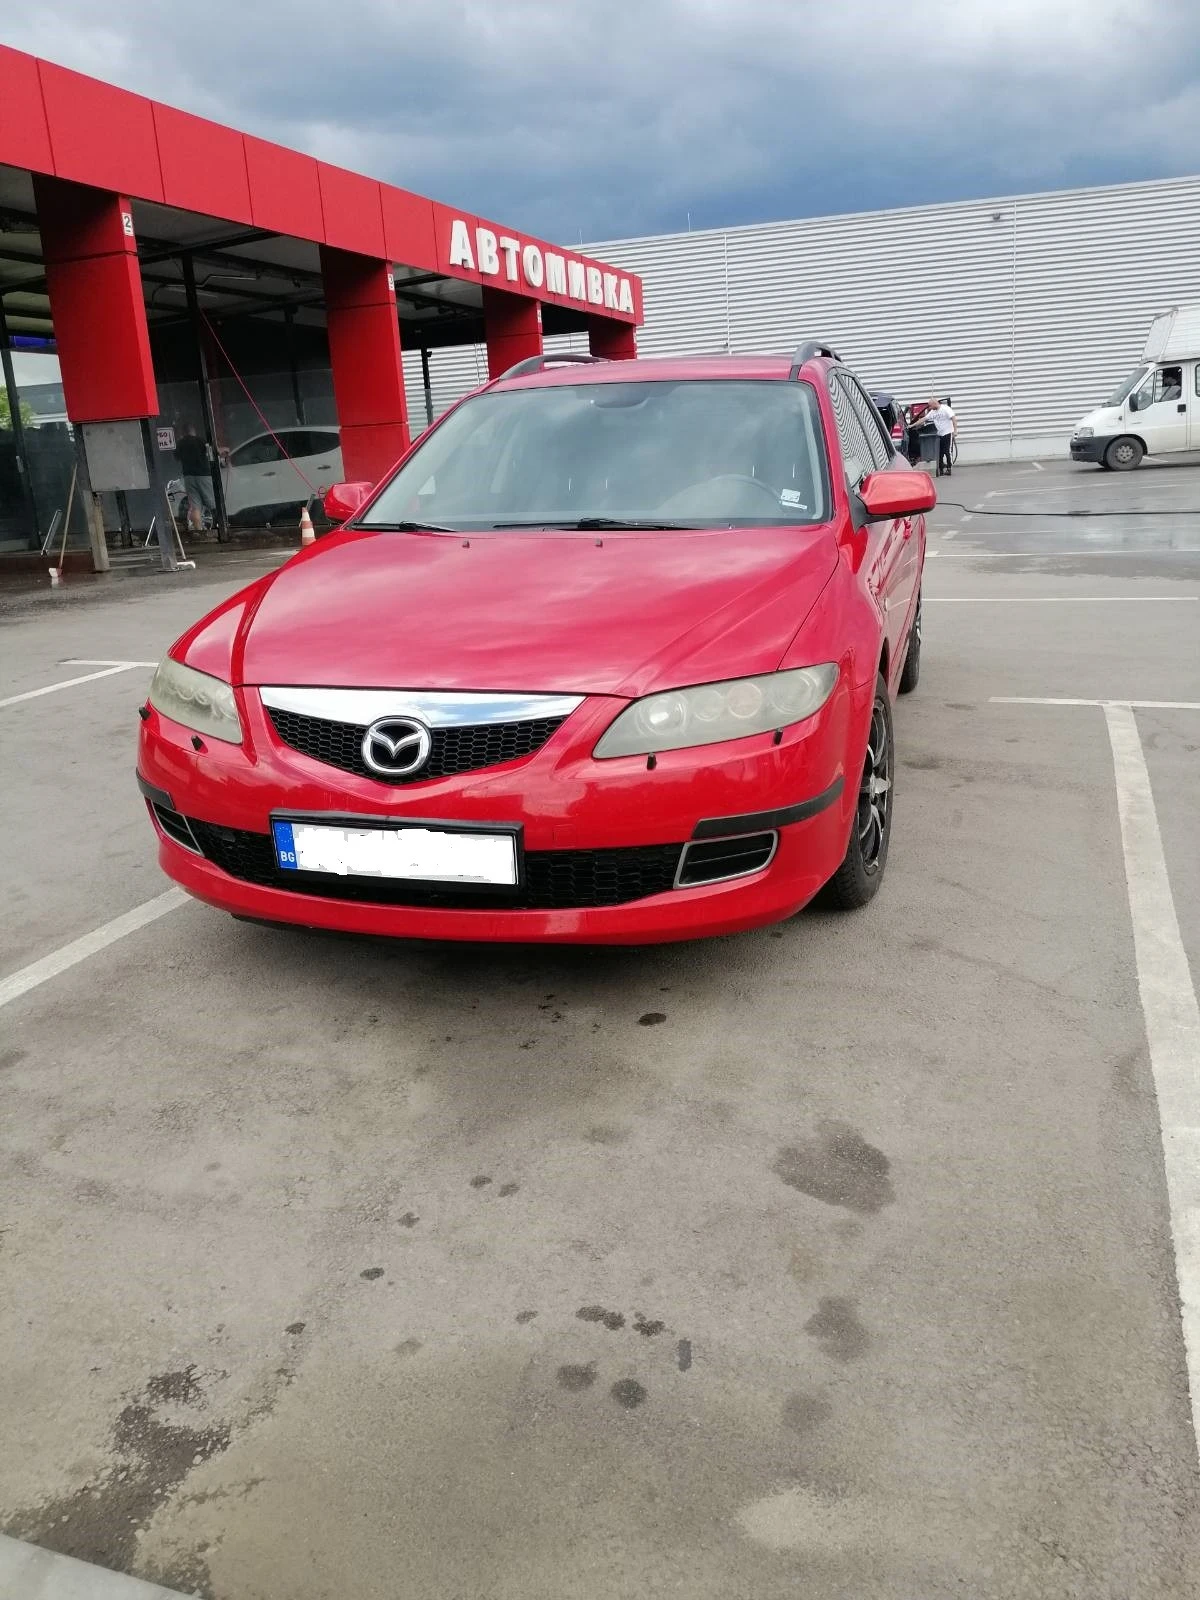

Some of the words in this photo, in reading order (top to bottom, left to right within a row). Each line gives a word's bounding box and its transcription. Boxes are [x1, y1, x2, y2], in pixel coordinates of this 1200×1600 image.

[124, 215, 131, 228] 2
[450, 219, 634, 314] АВТОМИВКА
[280, 850, 295, 862] BG
